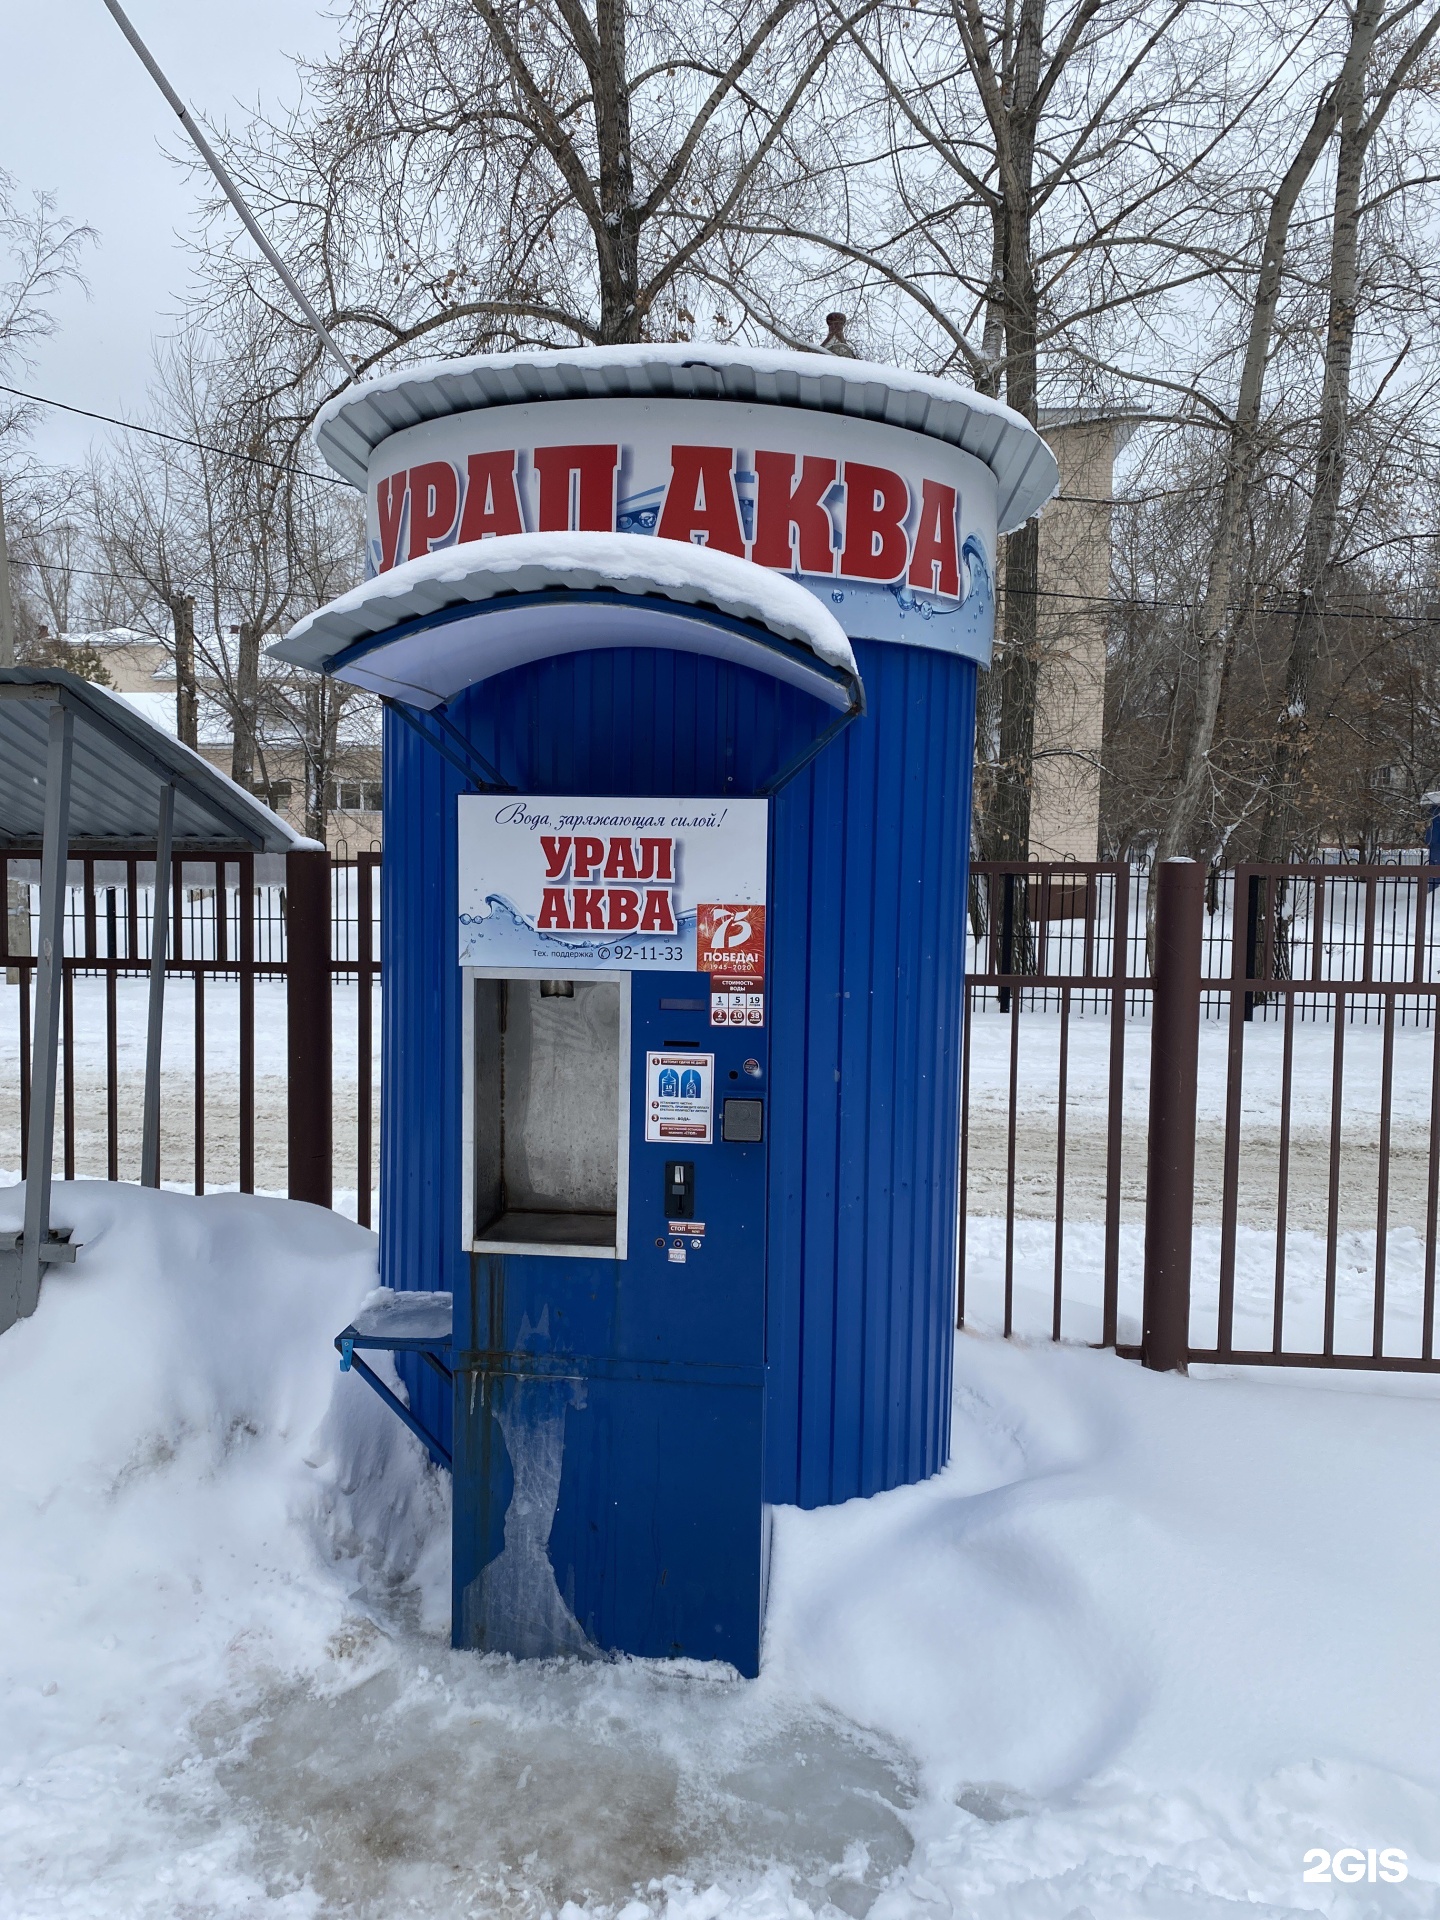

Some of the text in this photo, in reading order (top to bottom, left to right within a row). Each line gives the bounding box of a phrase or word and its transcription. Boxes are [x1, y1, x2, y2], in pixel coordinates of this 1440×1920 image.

[656, 444, 961, 600] АКВА
[494, 802, 728, 831] Вода, заряжающая силой!
[538, 835, 675, 881] УРАЛ
[536, 887, 676, 933] АКВА
[711, 908, 753, 949] 75
[532, 945, 683, 961] Тех. поддержка 92-11-33
[703, 951, 759, 964] ПОБЕДА!
